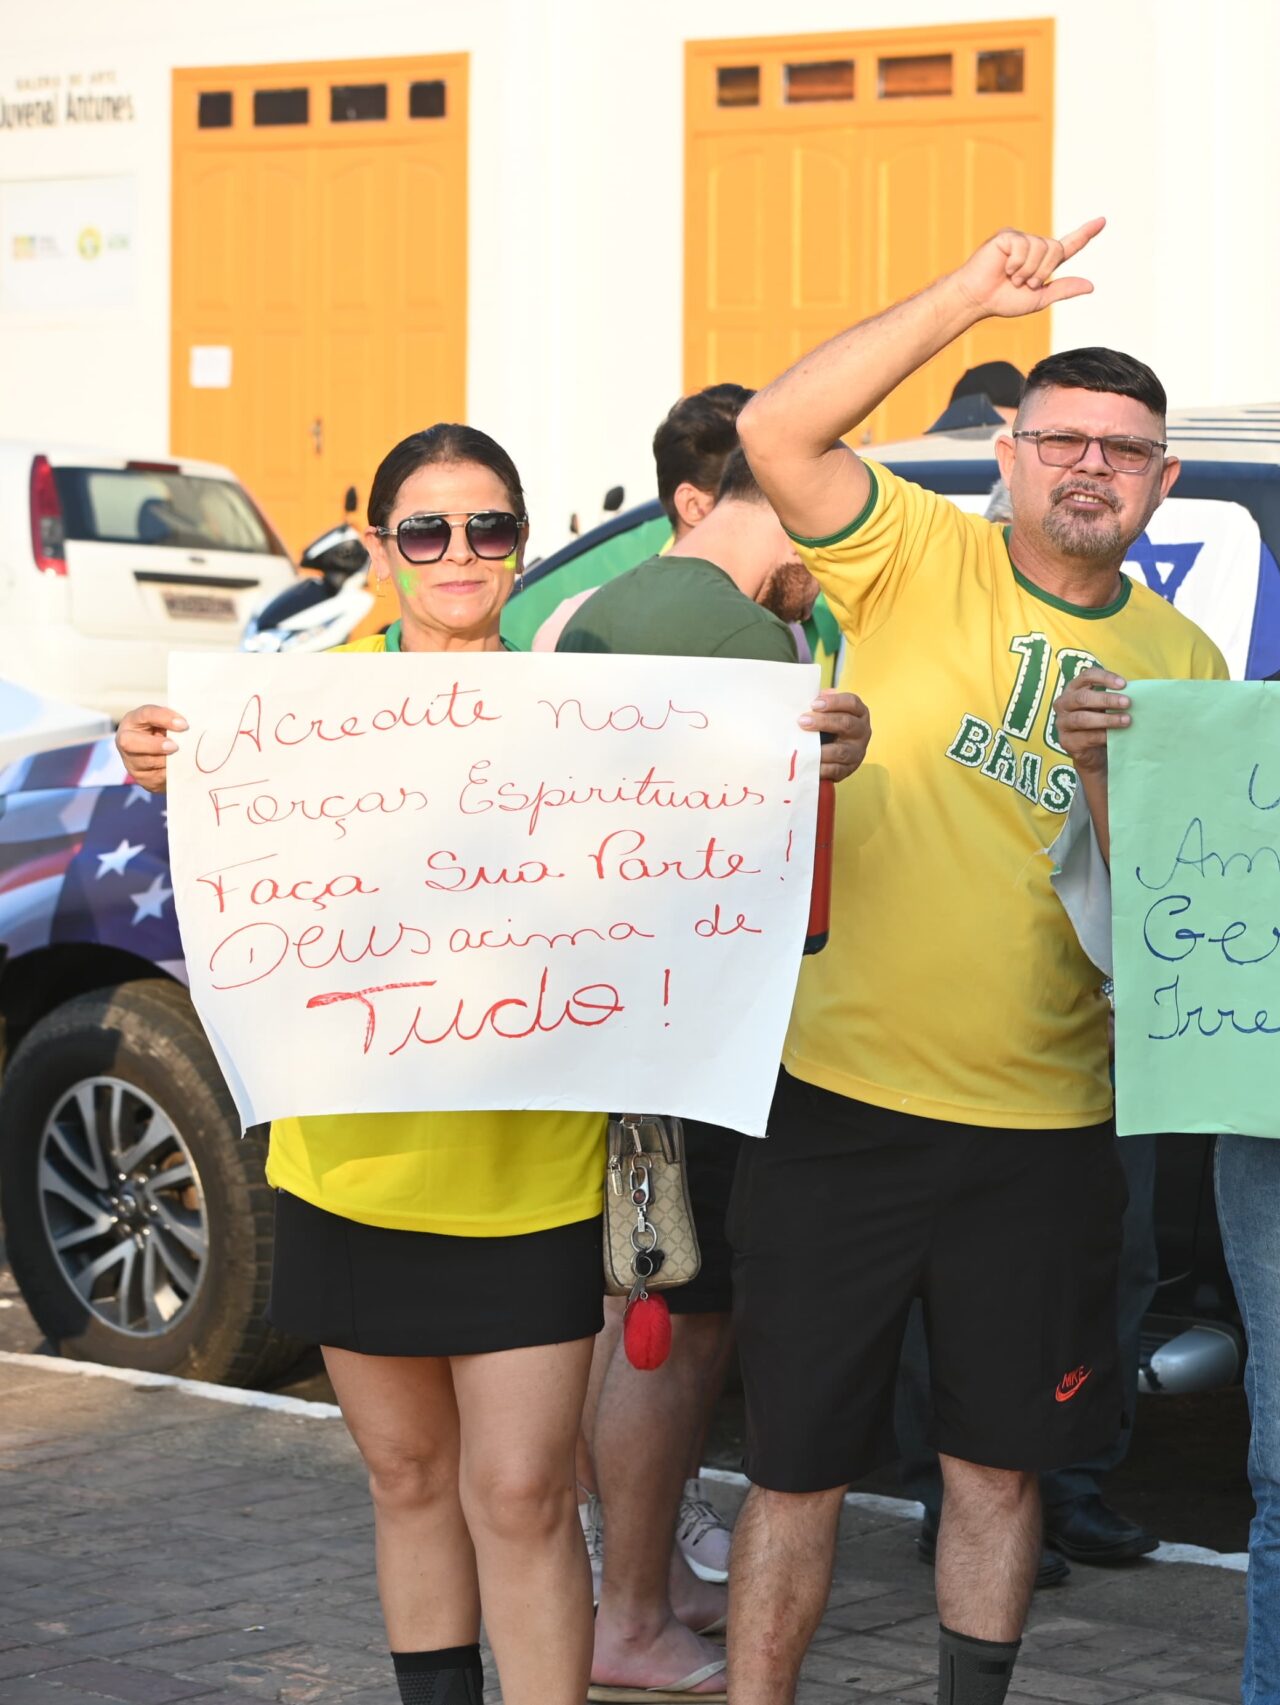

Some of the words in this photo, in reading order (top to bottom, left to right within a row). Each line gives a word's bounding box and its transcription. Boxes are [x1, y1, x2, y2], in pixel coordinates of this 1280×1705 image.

[196, 682, 502, 774] Acredite
[208, 779, 428, 840] Forças
[196, 854, 380, 913] Faça
[425, 850, 566, 893] Sua
[694, 904, 763, 938] de
